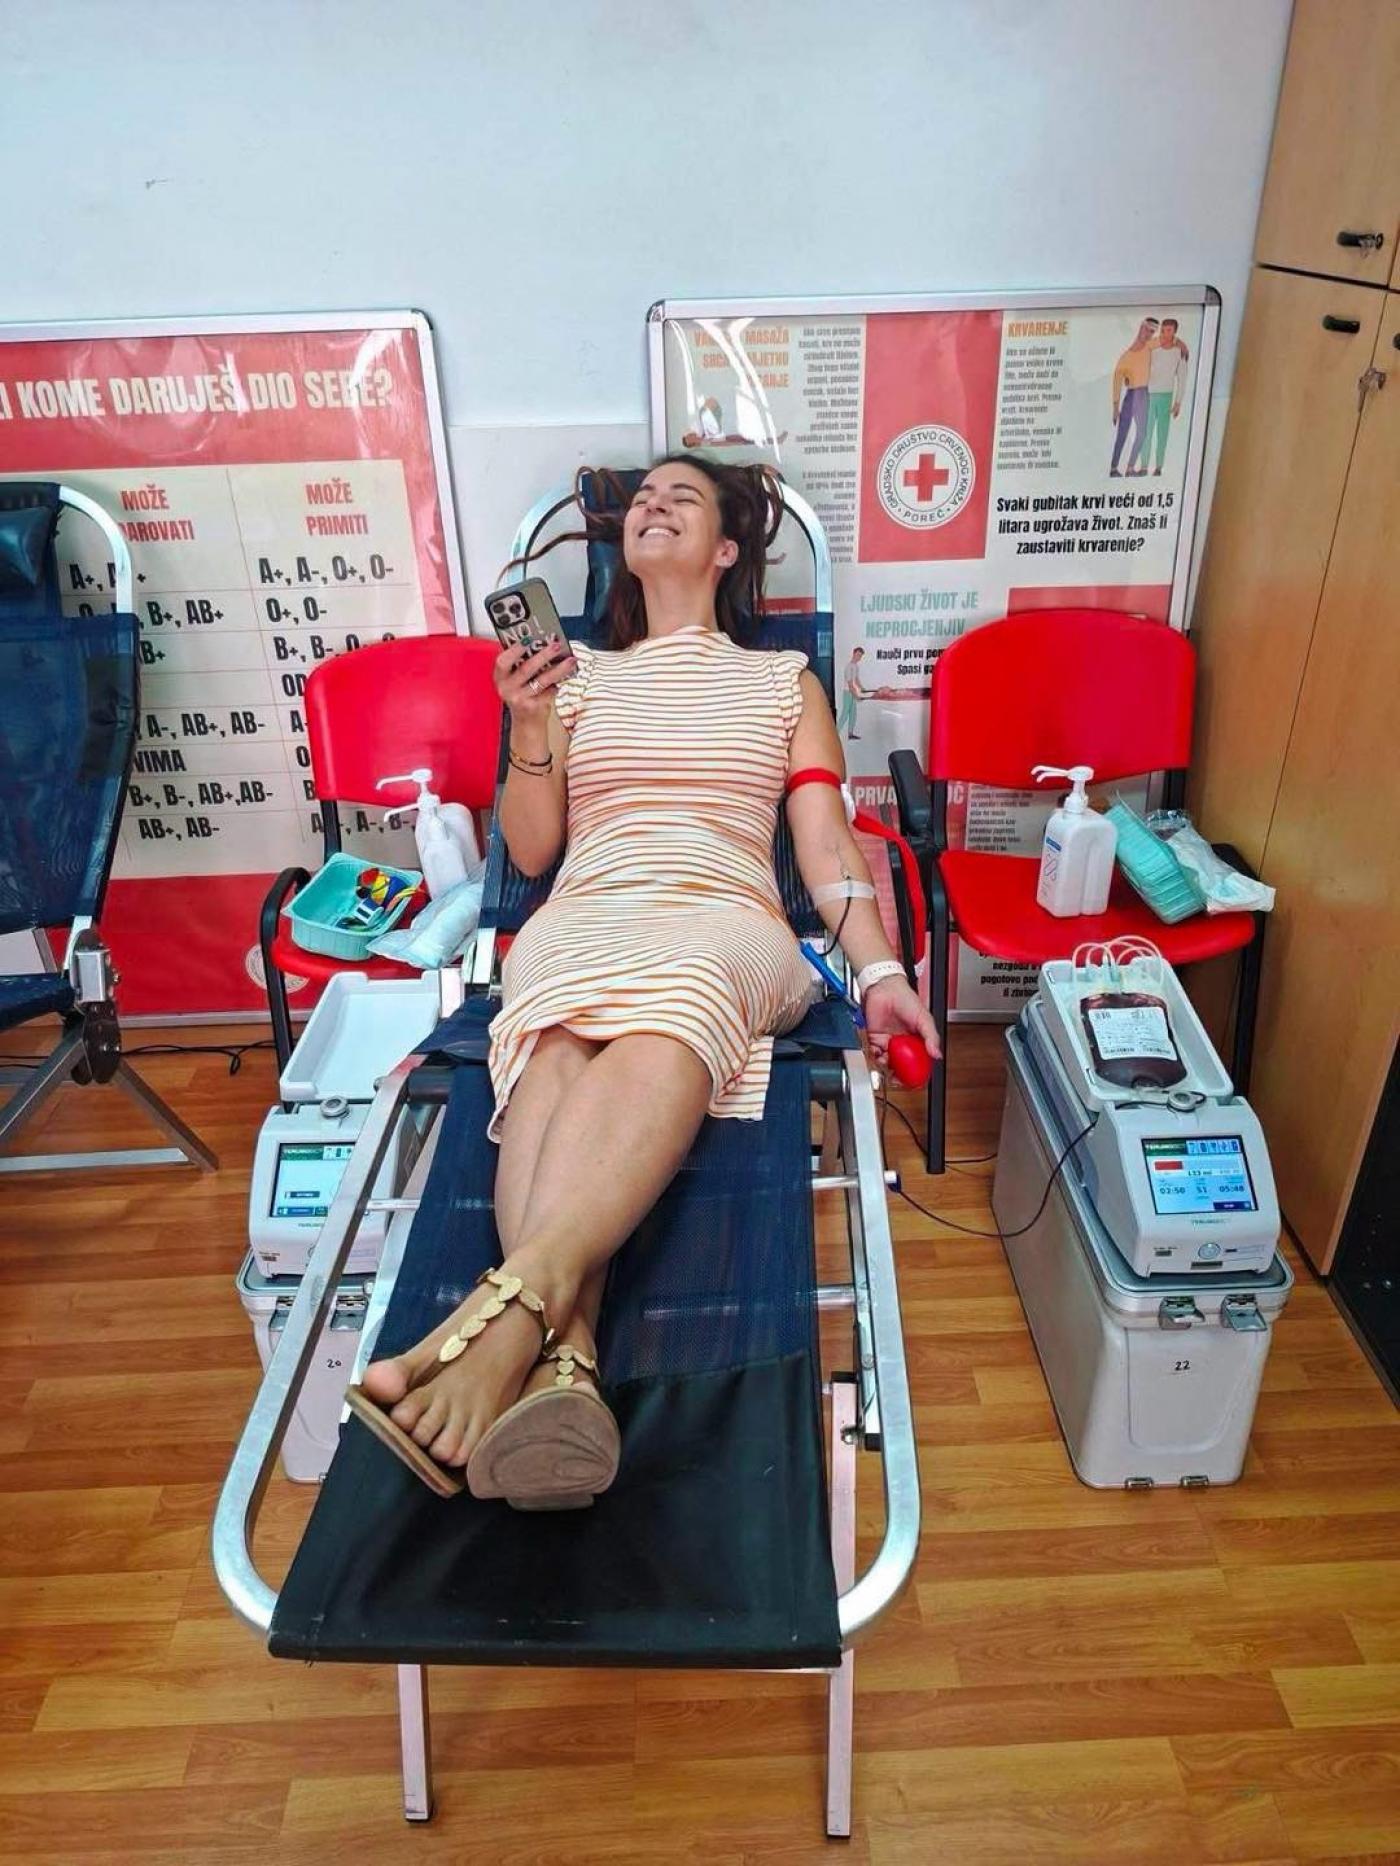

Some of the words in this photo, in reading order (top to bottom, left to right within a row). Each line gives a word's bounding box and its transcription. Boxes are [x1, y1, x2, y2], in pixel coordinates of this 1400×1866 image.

[1008, 321, 1069, 337] KRVARENJE
[16, 379, 106, 419] KOME
[109, 362, 245, 415] DARUJEŠ
[248, 371, 299, 411] DIO
[303, 368, 393, 410] SEBE?
[892, 430, 937, 458] DRUŠTVO
[938, 433, 969, 475] CRVENOG
[120, 483, 170, 511] MOŽE
[305, 478, 353, 505] MOŽE
[996, 496, 1030, 513] Svaki
[1032, 495, 1078, 513] gubitak
[1081, 494, 1106, 510] krvi
[1108, 492, 1135, 509] veći
[1137, 493, 1155, 507] od
[1157, 492, 1174, 509] 1,5
[305, 514, 369, 536] PRIMITI
[998, 518, 1030, 534] litara
[1033, 515, 1089, 534] ugrožava
[1092, 515, 1124, 531] život.
[1127, 513, 1156, 531] Znaš
[1159, 514, 1168, 529] li
[1016, 538, 1076, 555] zaustaviti
[1078, 536, 1145, 553] krvarenje?
[258, 557, 291, 586] A+,
[296, 556, 328, 585] A-,
[331, 555, 365, 583] O+,
[370, 554, 394, 580] O-
[185, 599, 224, 624] AB+
[266, 597, 299, 625] O+,
[303, 596, 327, 621] O-
[860, 593, 917, 613] LJUDSKI
[919, 588, 959, 611] ŽIVOT
[961, 591, 978, 609] JE
[865, 618, 966, 639] NEPROCJENJIV
[877, 648, 902, 660] Nauči
[903, 649, 924, 661] prvu
[897, 664, 922, 675] Spasi
[146, 714, 177, 740] A-,
[181, 713, 226, 738] AB+,
[230, 711, 266, 735] AB-
[138, 818, 182, 841] AB+,
[185, 817, 220, 838] AB-
[1175, 1360, 1191, 1371] 22
